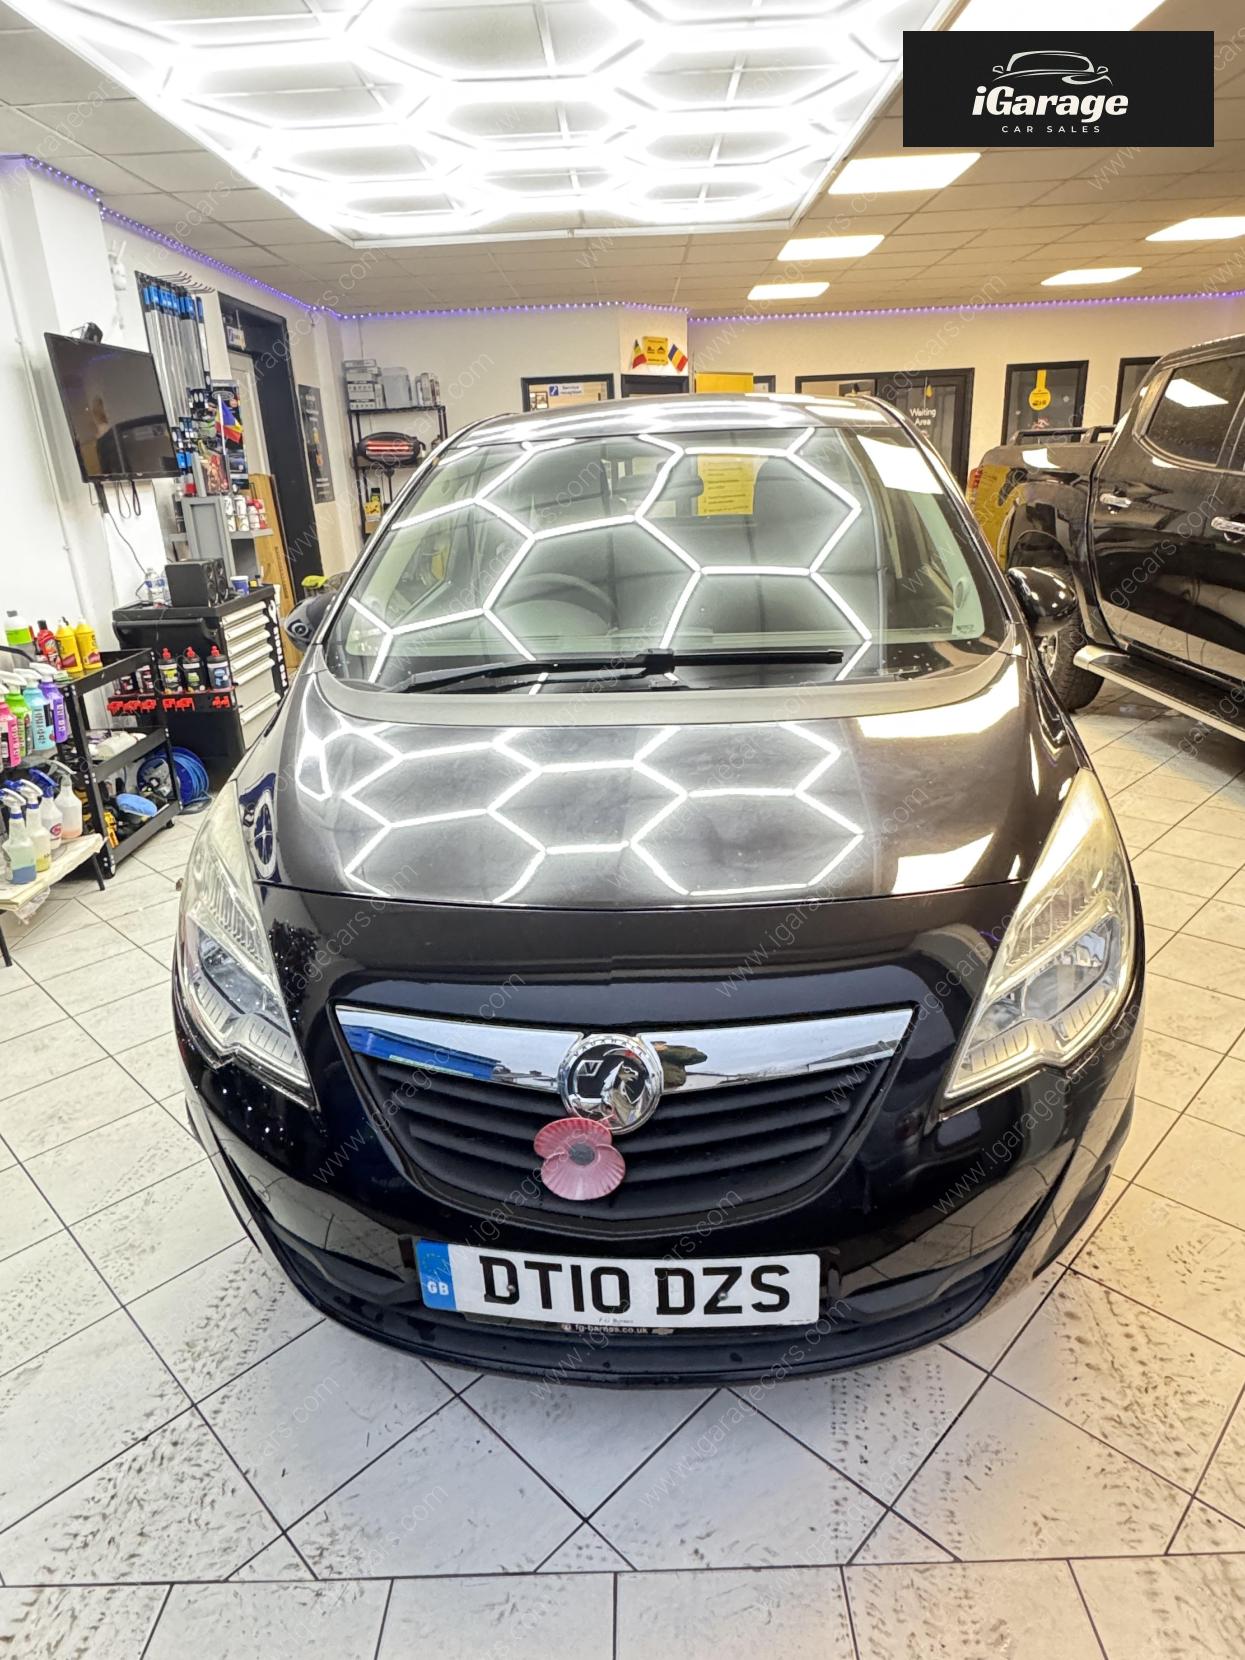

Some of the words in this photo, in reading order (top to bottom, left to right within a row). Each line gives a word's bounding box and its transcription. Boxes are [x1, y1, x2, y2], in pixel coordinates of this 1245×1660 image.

[910, 408, 936, 417] Waiting
[426, 1280, 450, 1296] GB
[479, 1255, 630, 1314] DT10
[655, 1264, 790, 1316] DZS
